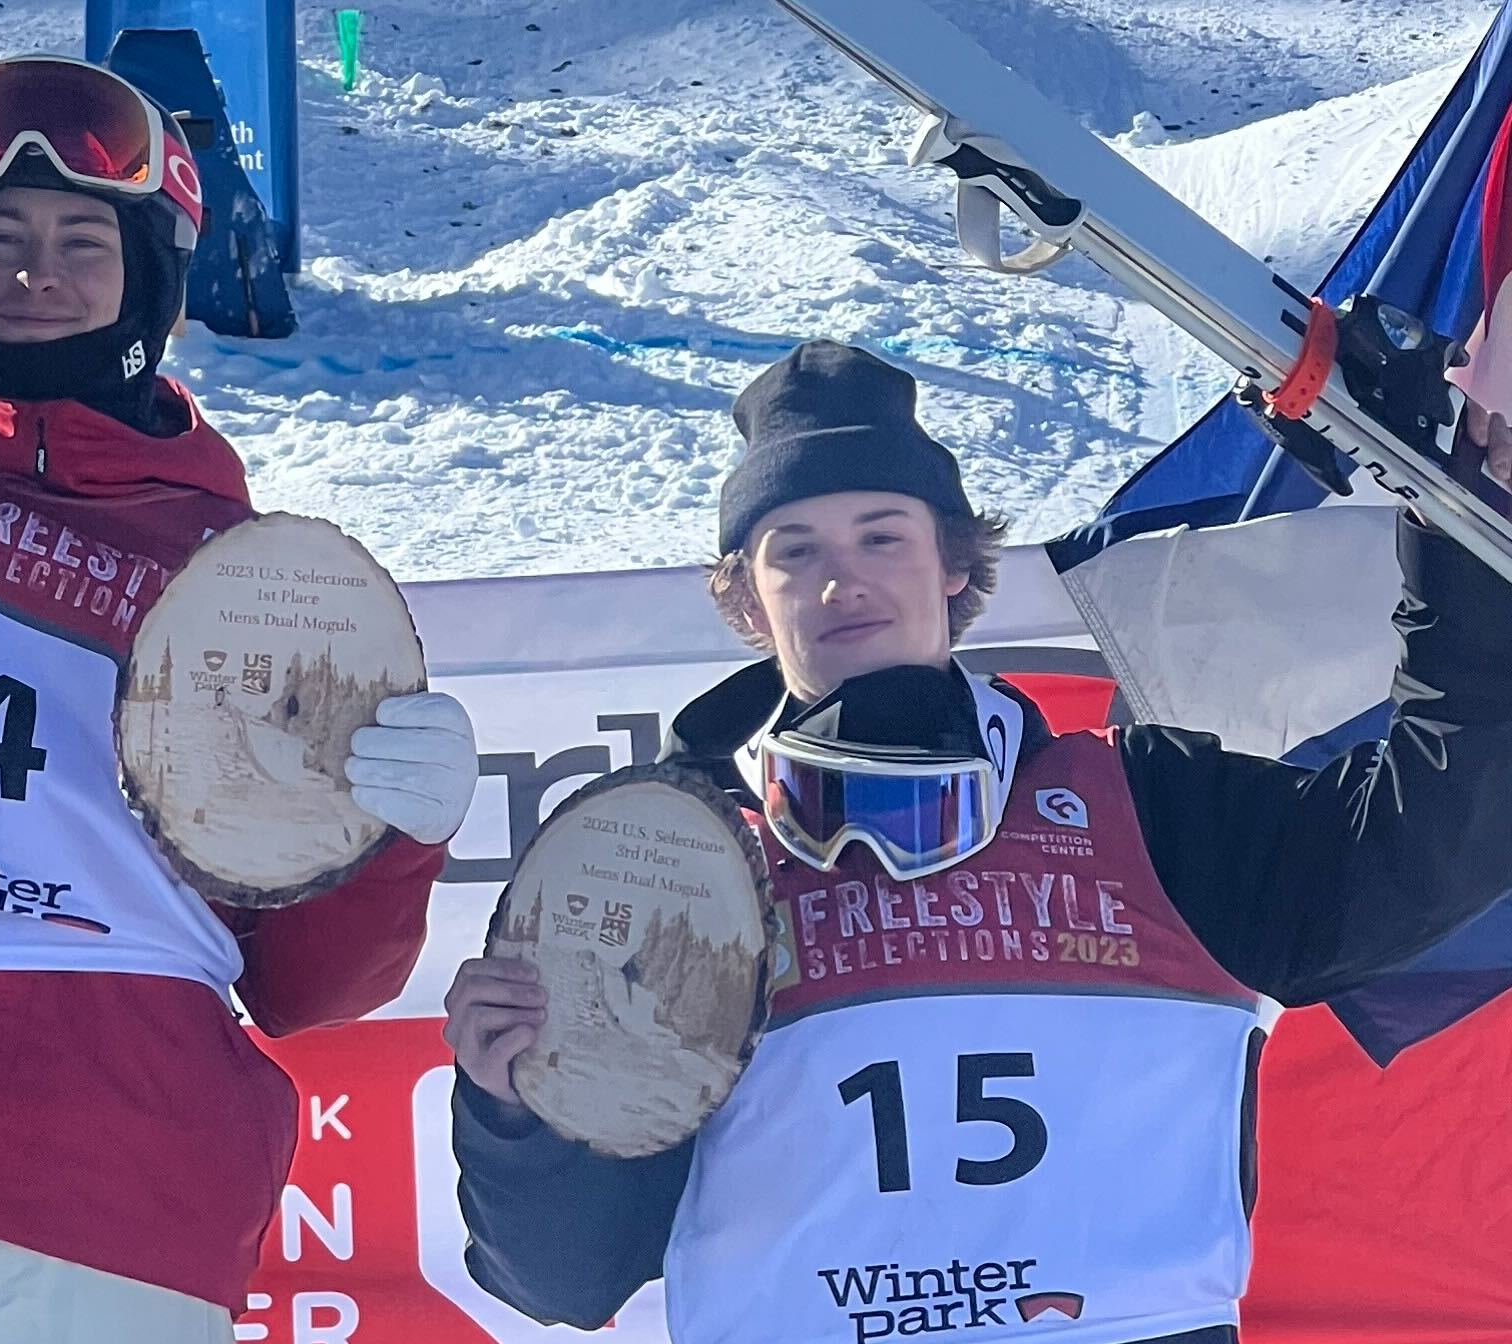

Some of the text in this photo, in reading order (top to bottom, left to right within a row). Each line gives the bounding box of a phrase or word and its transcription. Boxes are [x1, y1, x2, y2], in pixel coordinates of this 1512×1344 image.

[216, 563, 254, 579] 2023
[293, 569, 368, 588] Selections
[258, 589, 320, 605] 1st Place
[219, 610, 358, 635] Mens Dual Moguls
[244, 653, 273, 669] US
[582, 816, 618, 834] 2023
[655, 829, 726, 854] Selections
[1001, 831, 1092, 846] COMPETITION
[616, 844, 681, 868] 3rd Place
[1042, 844, 1094, 856] CENTER
[581, 863, 712, 899] Mens Dual Moguls
[604, 900, 633, 920] US
[799, 871, 1133, 947] FREESTYLE
[808, 930, 1050, 981] SELECTIONS
[1057, 933, 1140, 968] 2023
[837, 1052, 1048, 1193] 15
[817, 1259, 1037, 1308] Winter
